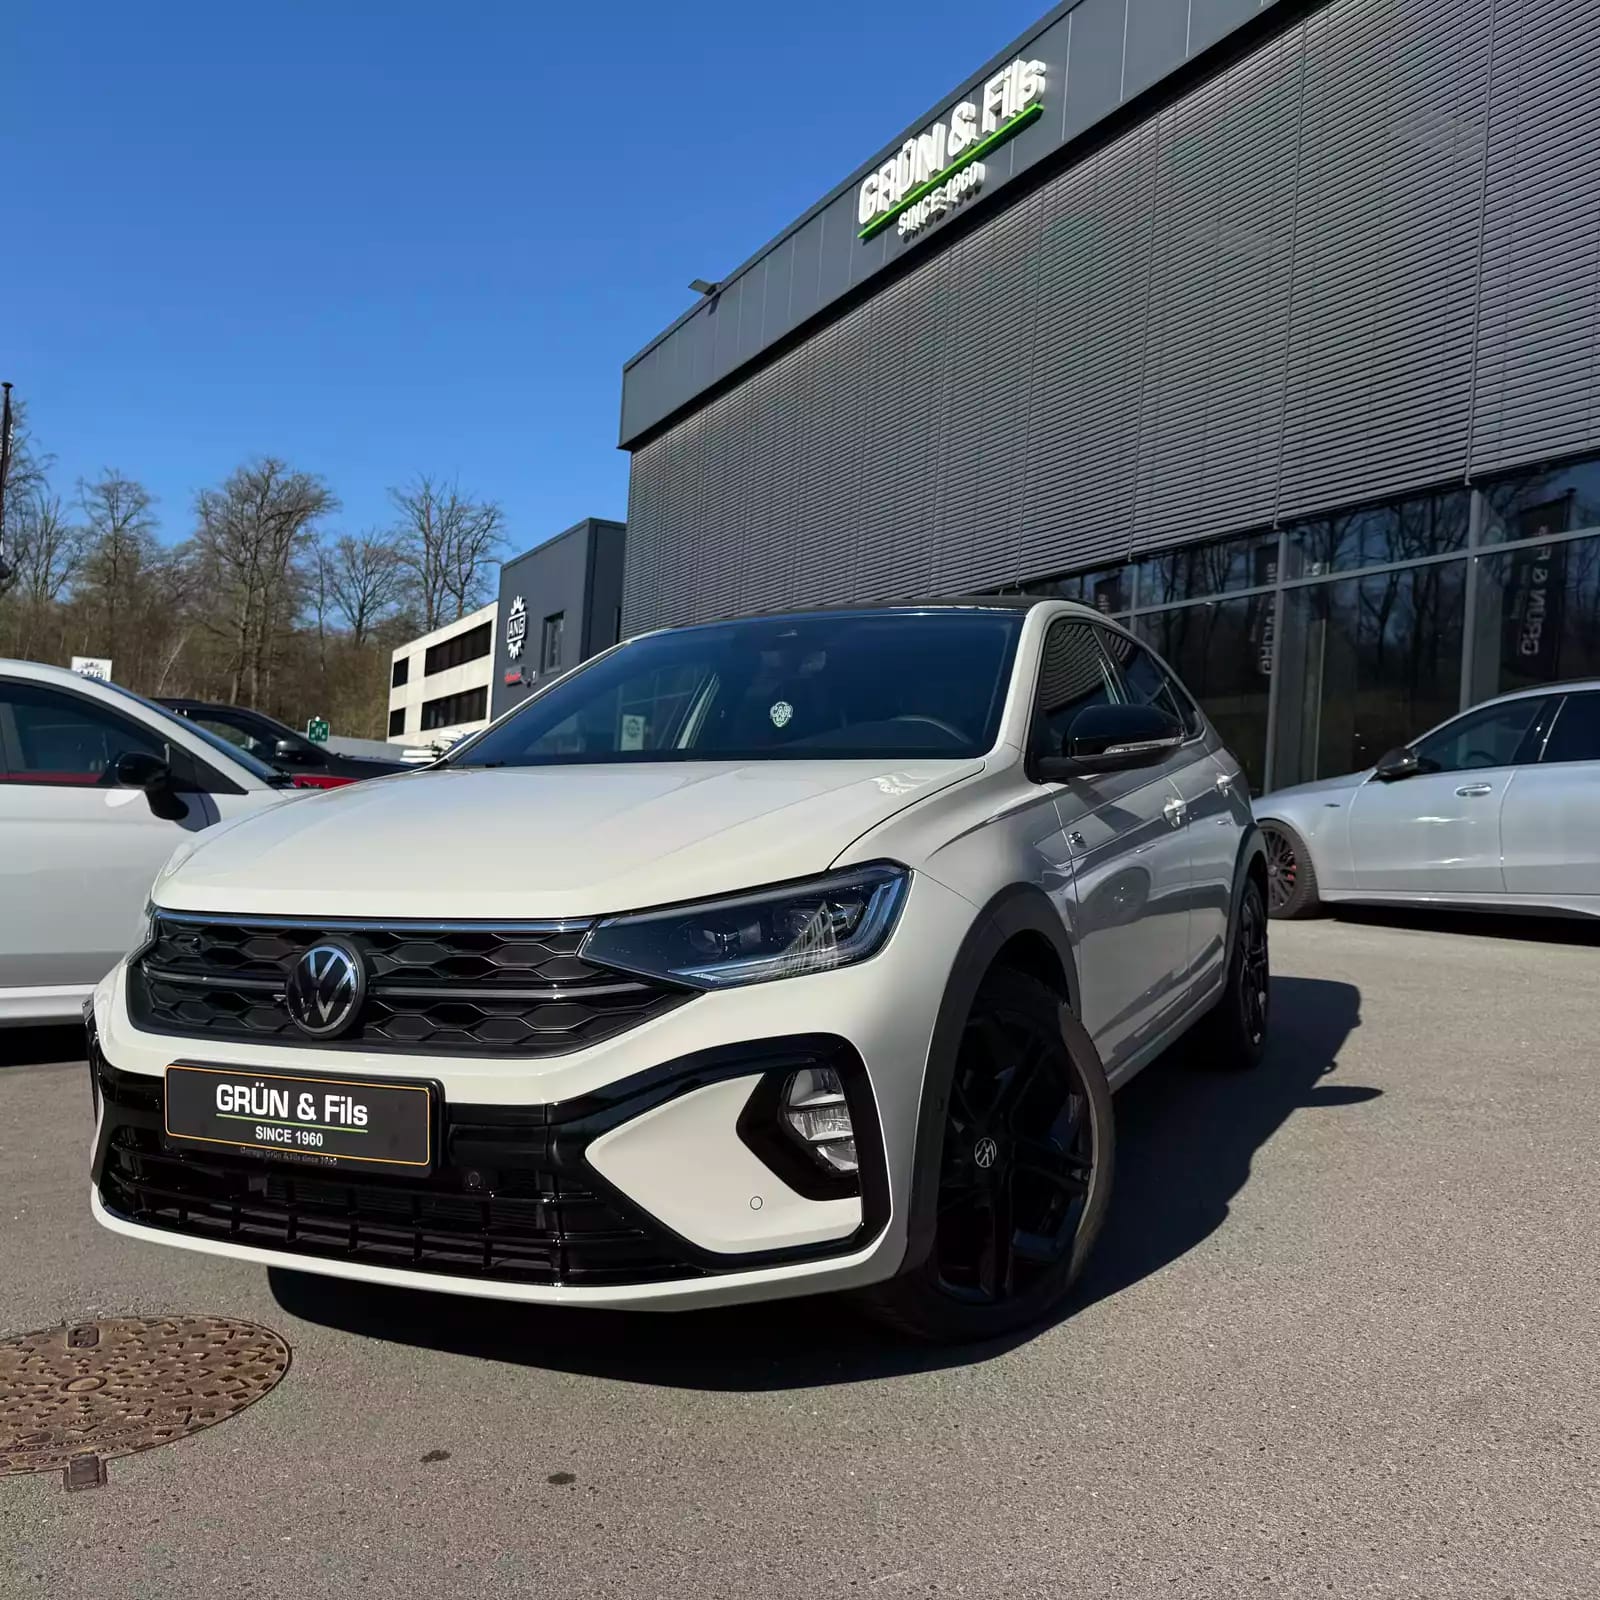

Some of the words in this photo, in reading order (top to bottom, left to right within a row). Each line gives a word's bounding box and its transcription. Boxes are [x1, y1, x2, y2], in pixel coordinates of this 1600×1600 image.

[859, 122, 946, 225] GRÜN
[948, 101, 980, 157] &
[982, 59, 1047, 135] Fils
[898, 186, 948, 236] SINCE
[946, 161, 986, 204] 1960
[216, 1082, 289, 1119] GRÜN
[297, 1093, 317, 1121] &
[325, 1095, 369, 1126] Fils
[255, 1126, 292, 1144] SINCE
[295, 1131, 324, 1147] 1960
